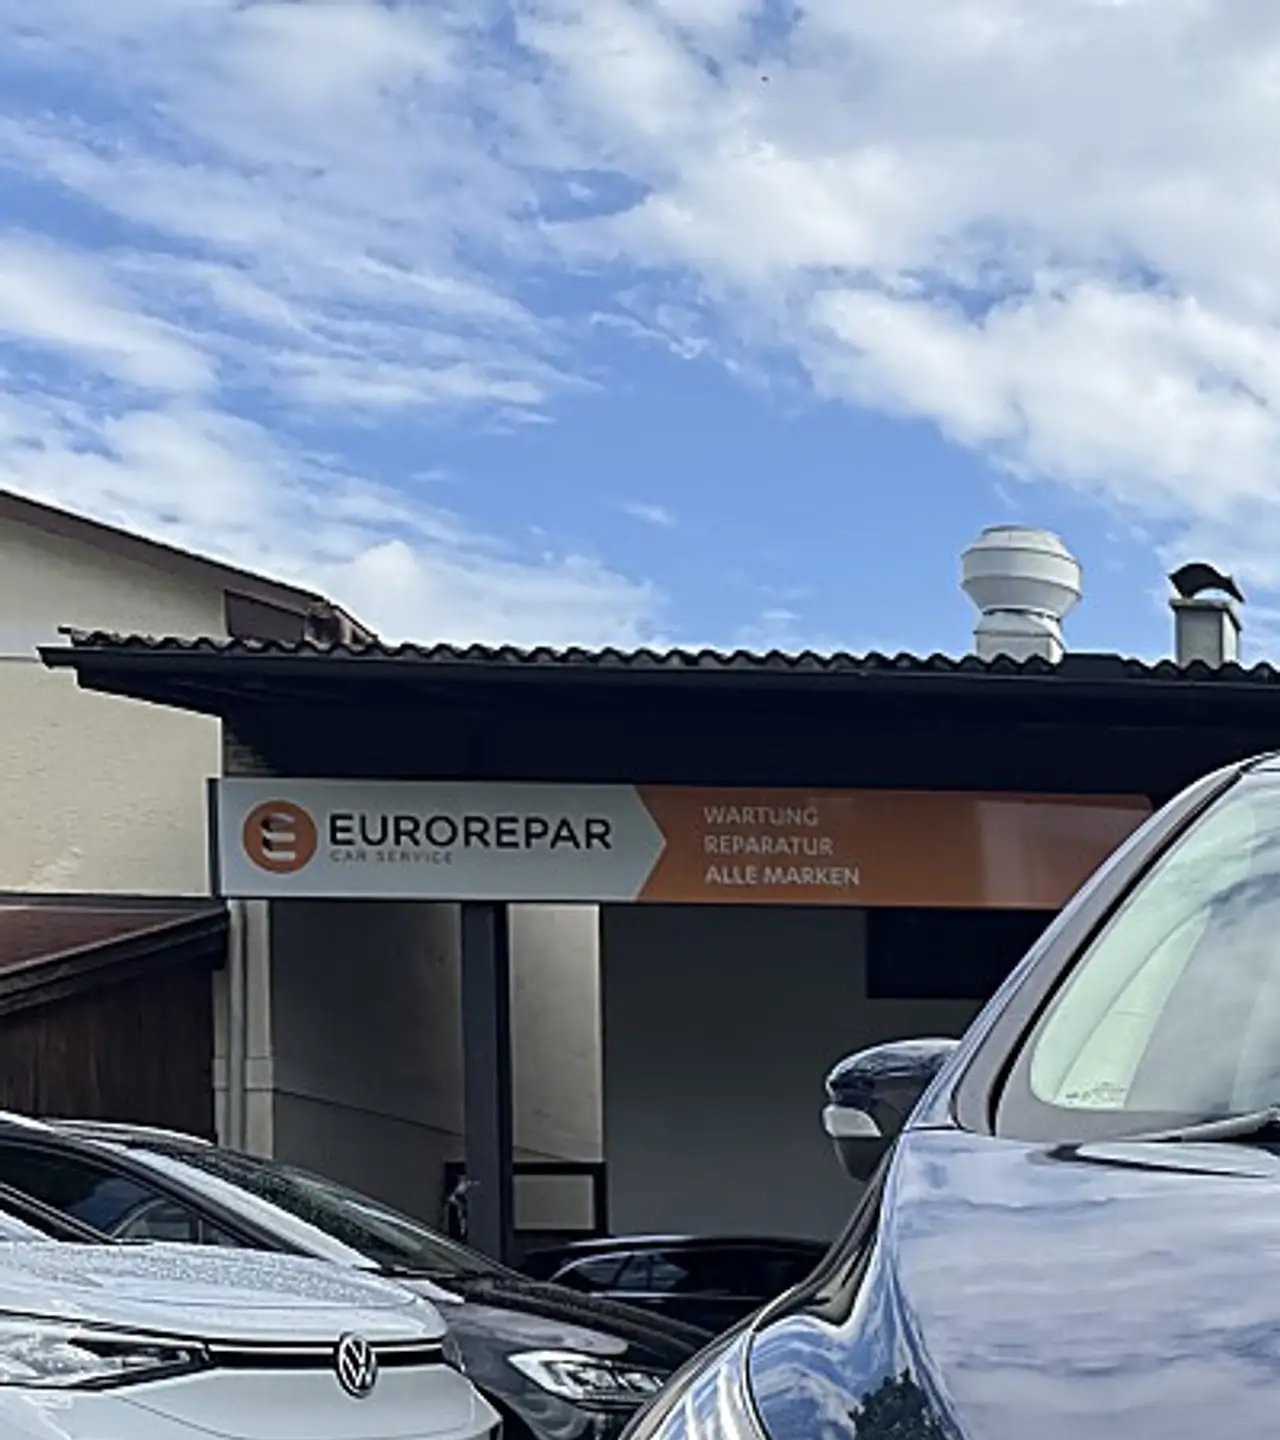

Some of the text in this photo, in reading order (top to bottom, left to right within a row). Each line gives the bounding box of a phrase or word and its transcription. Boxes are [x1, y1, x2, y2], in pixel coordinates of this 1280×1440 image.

[703, 805, 819, 827] WARTUNG
[328, 812, 613, 850] EUROREPAR
[703, 834, 834, 856] REPARATUR
[329, 850, 454, 865] CAR SERVICE
[704, 864, 861, 886] ALLE MARKEN
